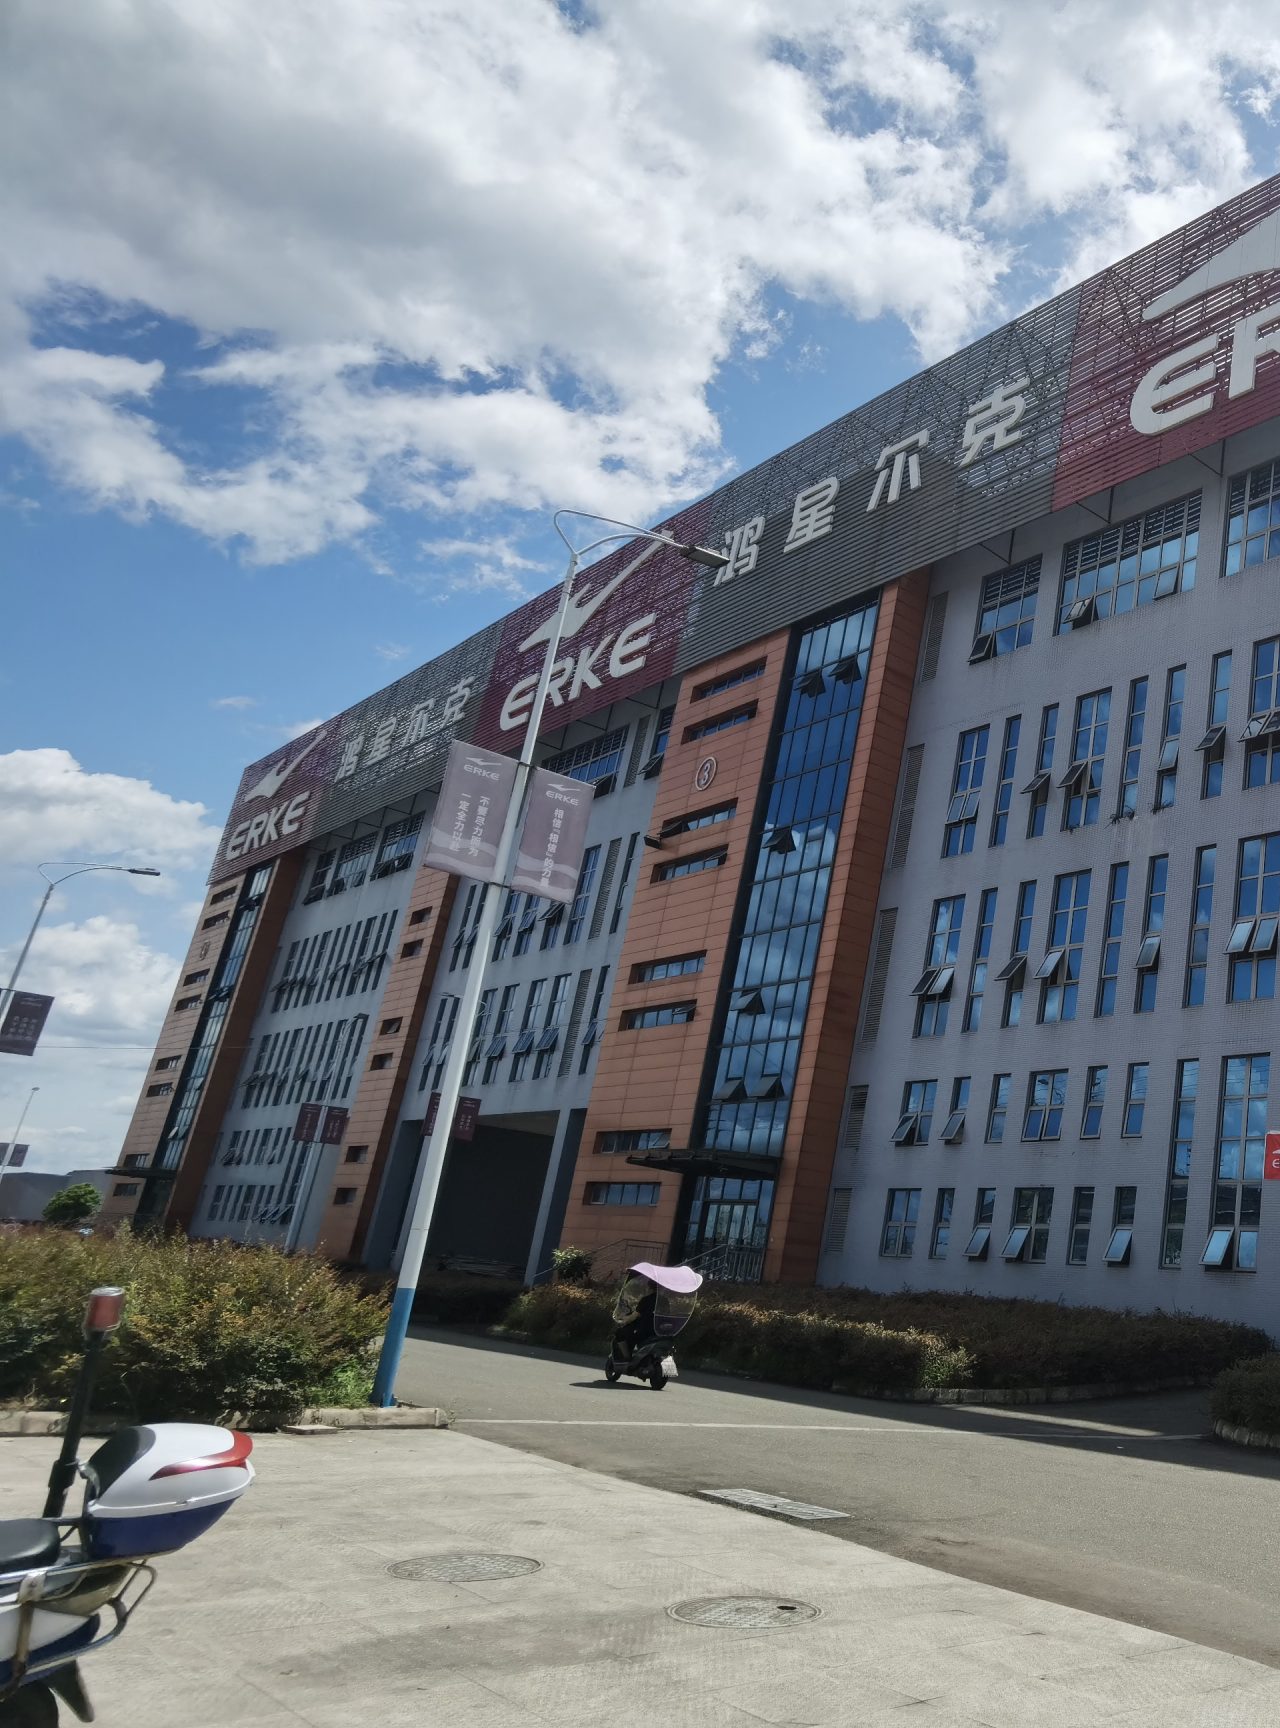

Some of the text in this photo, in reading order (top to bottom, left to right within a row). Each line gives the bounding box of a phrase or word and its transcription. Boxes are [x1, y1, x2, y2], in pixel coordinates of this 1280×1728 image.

[713, 377, 1030, 587] 鸿星尔克
[500, 612, 657, 731] ERKE
[334, 676, 475, 783] 鸿星尔克
[463, 764, 500, 781] ERKE
[225, 790, 311, 860] ERKE
[545, 790, 580, 807] ERKE
